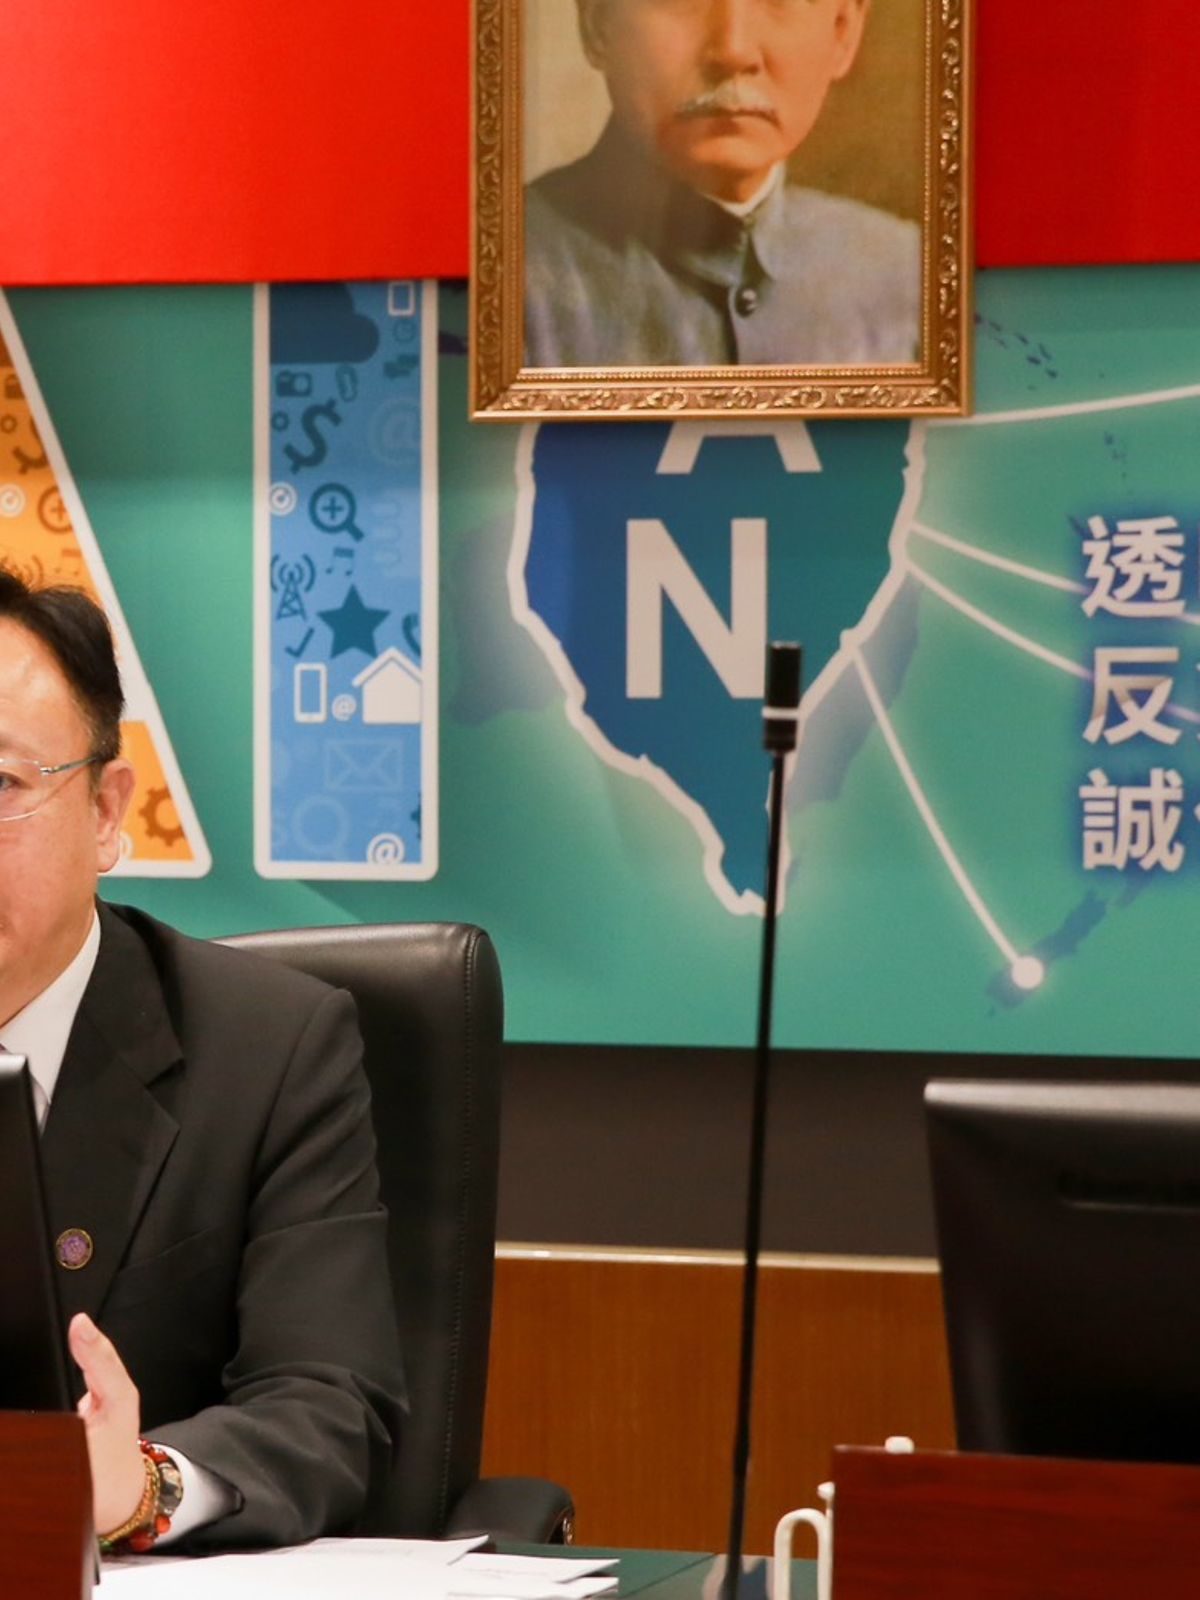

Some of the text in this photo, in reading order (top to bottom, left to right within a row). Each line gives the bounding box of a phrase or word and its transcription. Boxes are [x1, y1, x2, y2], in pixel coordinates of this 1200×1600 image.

[1080, 515, 1200, 619] 透
[1082, 646, 1200, 746] 反
[1078, 767, 1200, 872] 誠
